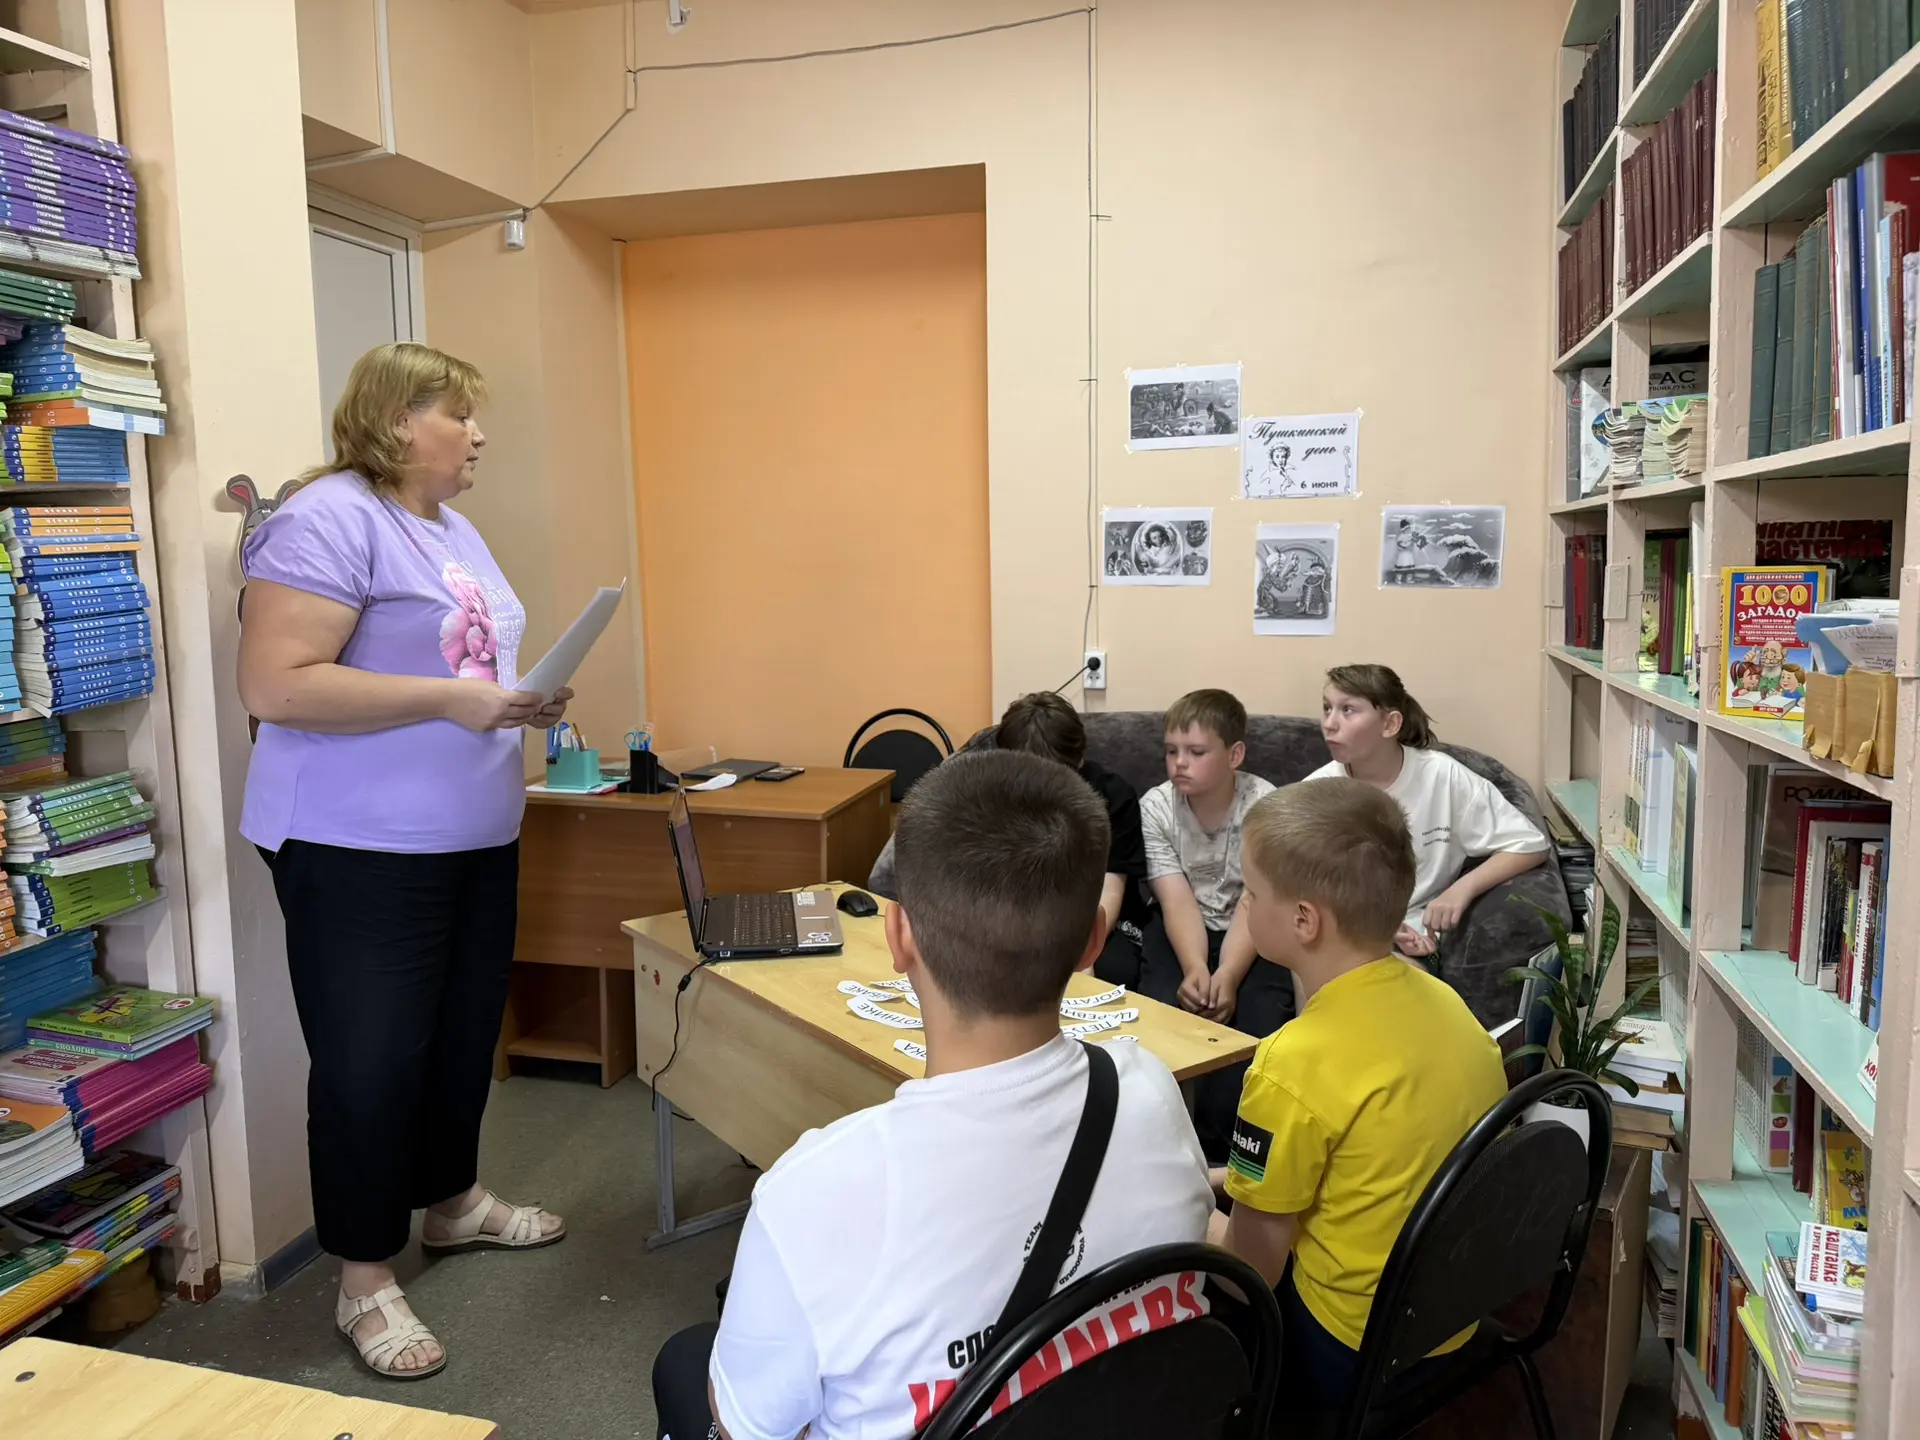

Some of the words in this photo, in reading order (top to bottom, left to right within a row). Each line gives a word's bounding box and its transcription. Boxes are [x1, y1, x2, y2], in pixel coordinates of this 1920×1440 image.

[1249, 421, 1347, 446] Пушкинский
[1301, 446, 1336, 461] день
[1300, 481, 1307, 489] 6
[1739, 585, 1808, 606] 1000
[1072, 1021, 1112, 1034] ПЕТУ
[55, 1043, 95, 1055] БИОЛОГИЯ
[1024, 1220, 1044, 1252] TEAM
[1059, 1236, 1086, 1285] VOLGOGRAD
